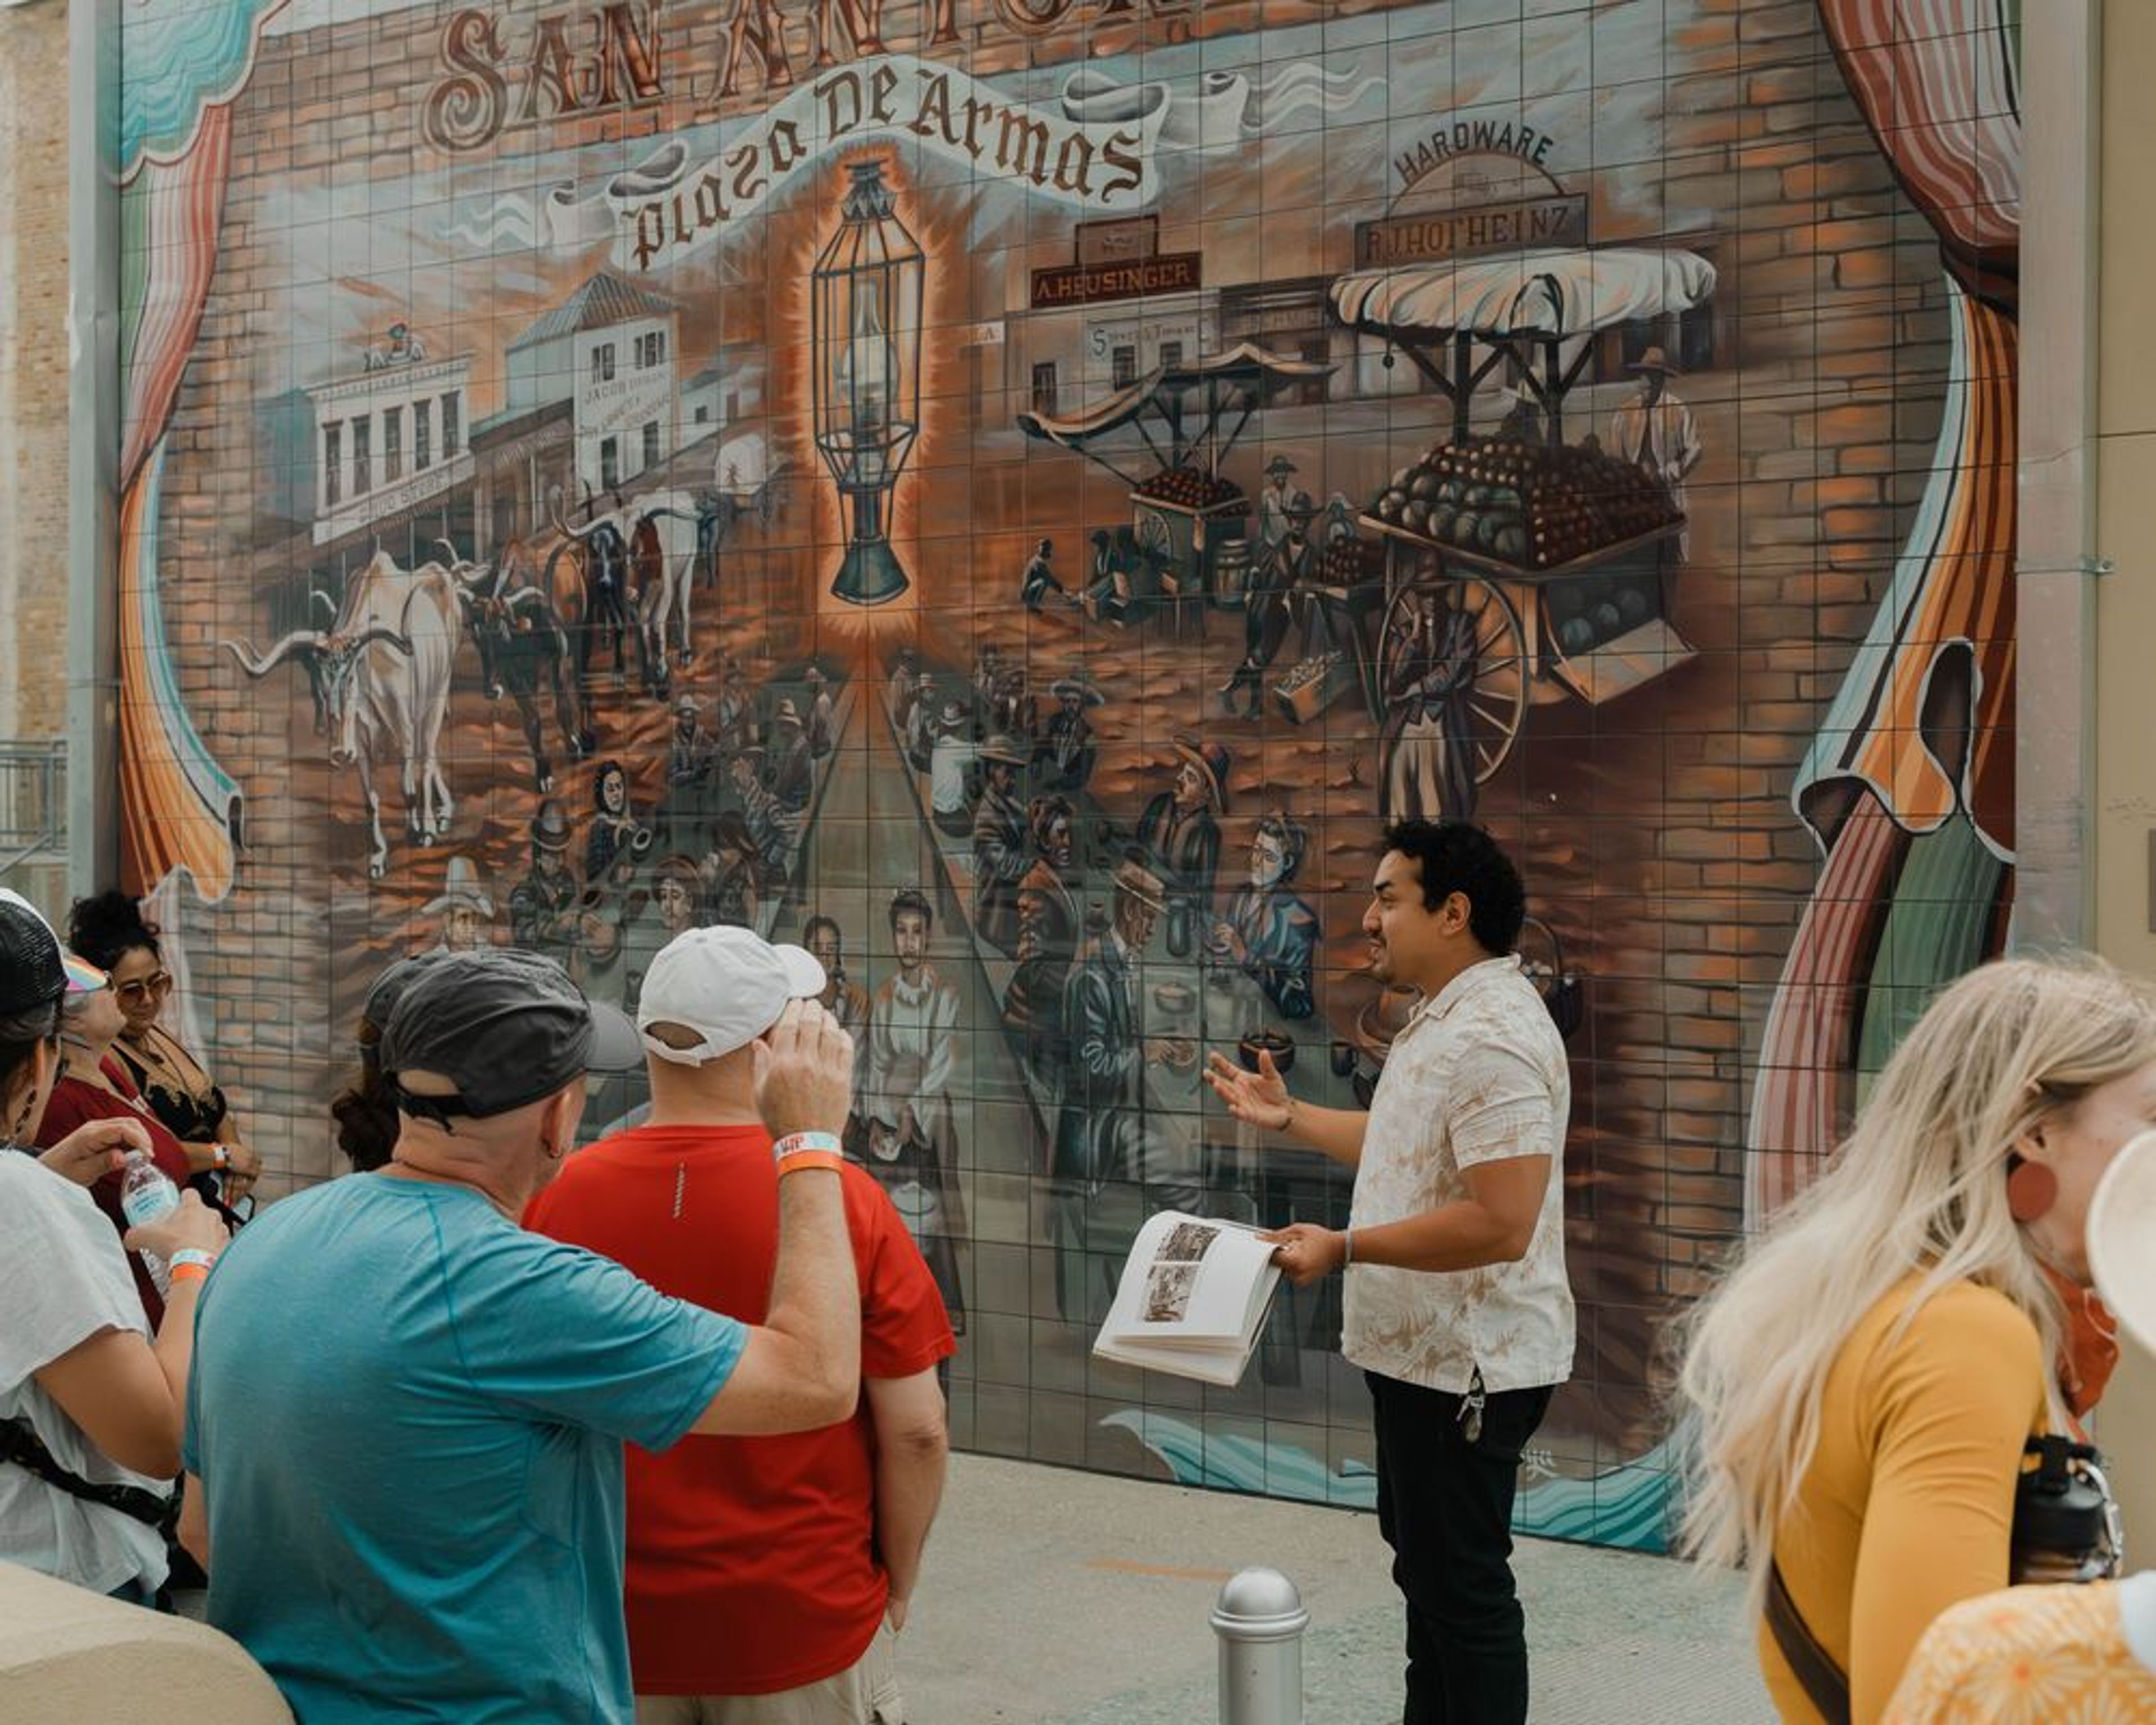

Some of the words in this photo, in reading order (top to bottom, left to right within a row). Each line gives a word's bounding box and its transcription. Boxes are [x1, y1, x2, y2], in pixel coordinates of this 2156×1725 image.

[425, 1, 667, 153] SAN
[814, 64, 898, 143] De
[906, 69, 1142, 203] Armas
[1395, 120, 1554, 188] HARDWARE
